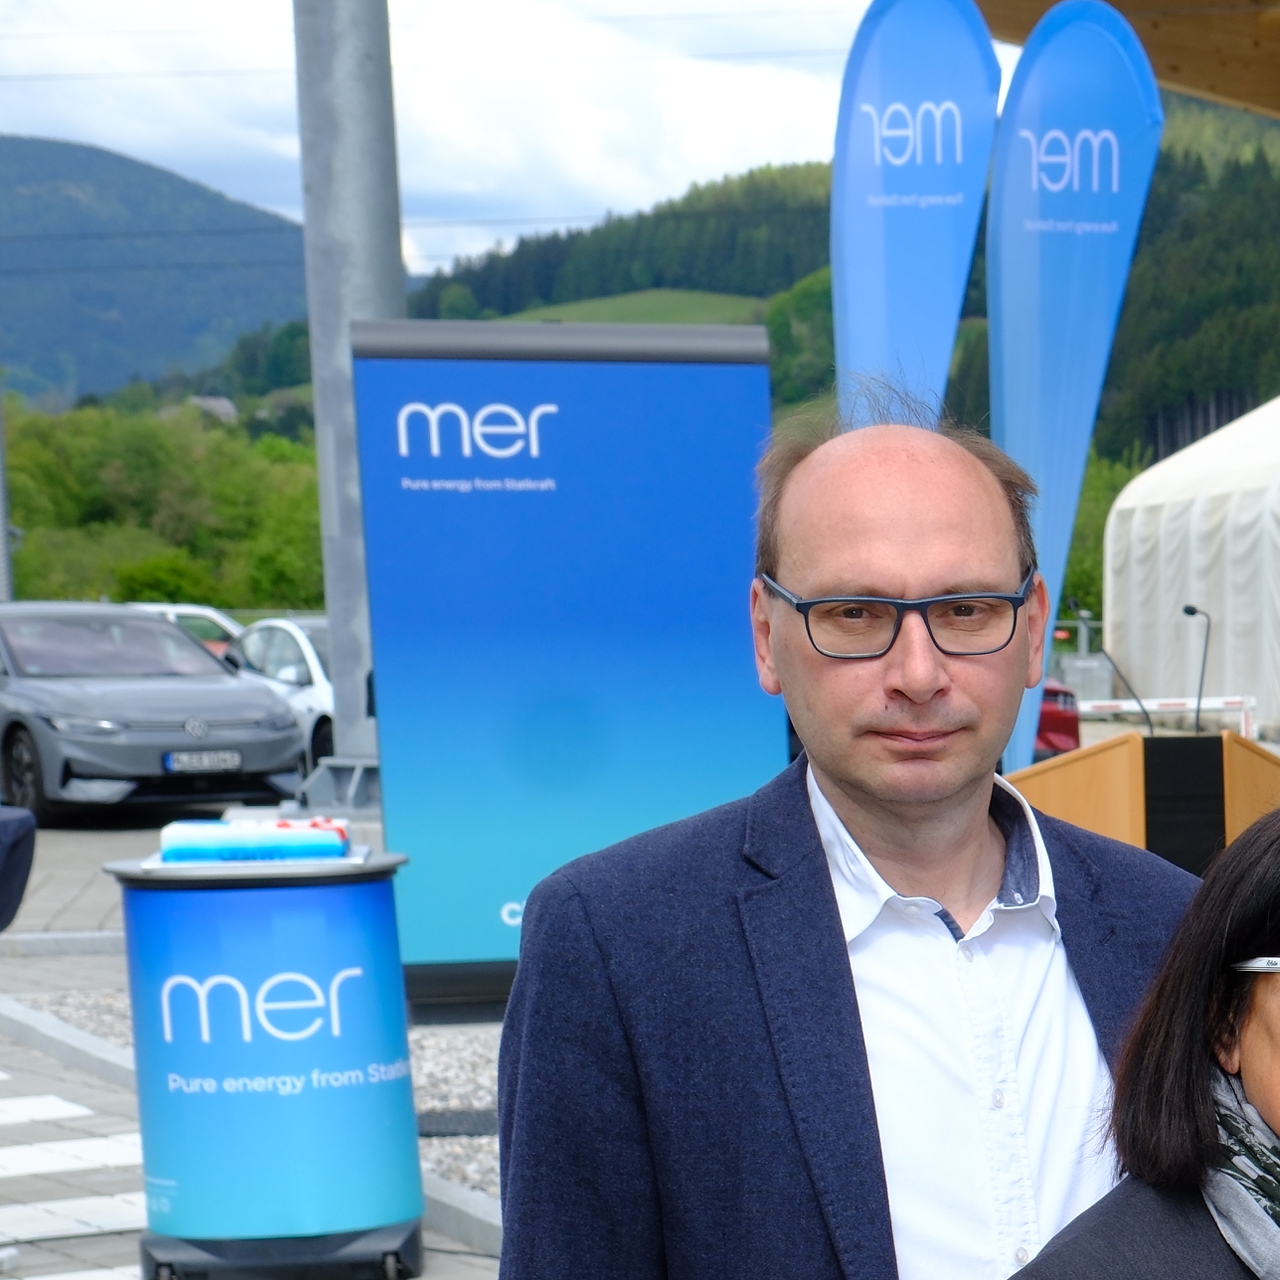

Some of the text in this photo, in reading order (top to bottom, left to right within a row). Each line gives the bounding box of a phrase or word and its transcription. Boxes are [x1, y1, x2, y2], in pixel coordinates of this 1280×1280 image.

[397, 402, 559, 458] mer
[161, 967, 363, 1043] mer
[167, 1072, 217, 1094] Pure
[222, 1073, 305, 1096] energy
[311, 1068, 364, 1088] from
